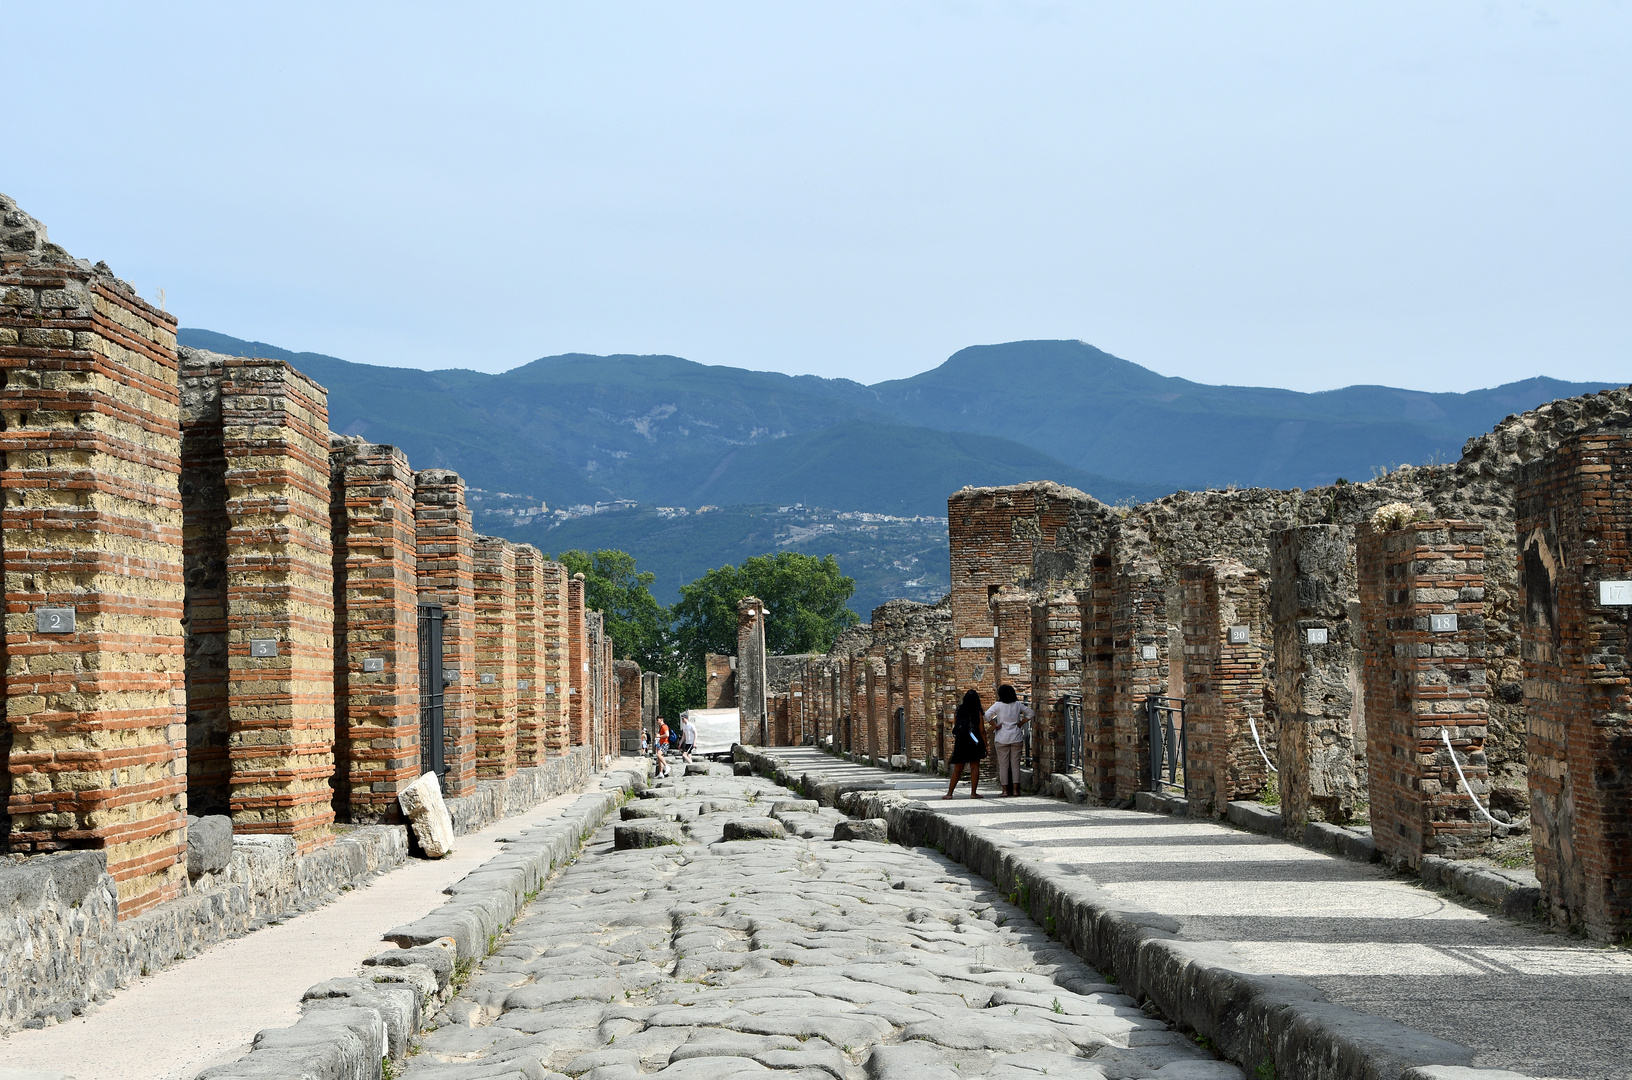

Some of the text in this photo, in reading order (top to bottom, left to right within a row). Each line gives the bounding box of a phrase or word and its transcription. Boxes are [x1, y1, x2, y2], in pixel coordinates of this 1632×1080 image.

[1609, 585, 1624, 600] 17
[50, 614, 60, 629] 2
[1436, 617, 1450, 629] 18
[1234, 631, 1245, 640] 20
[1312, 631, 1323, 641] 19
[259, 643, 267, 654] 3
